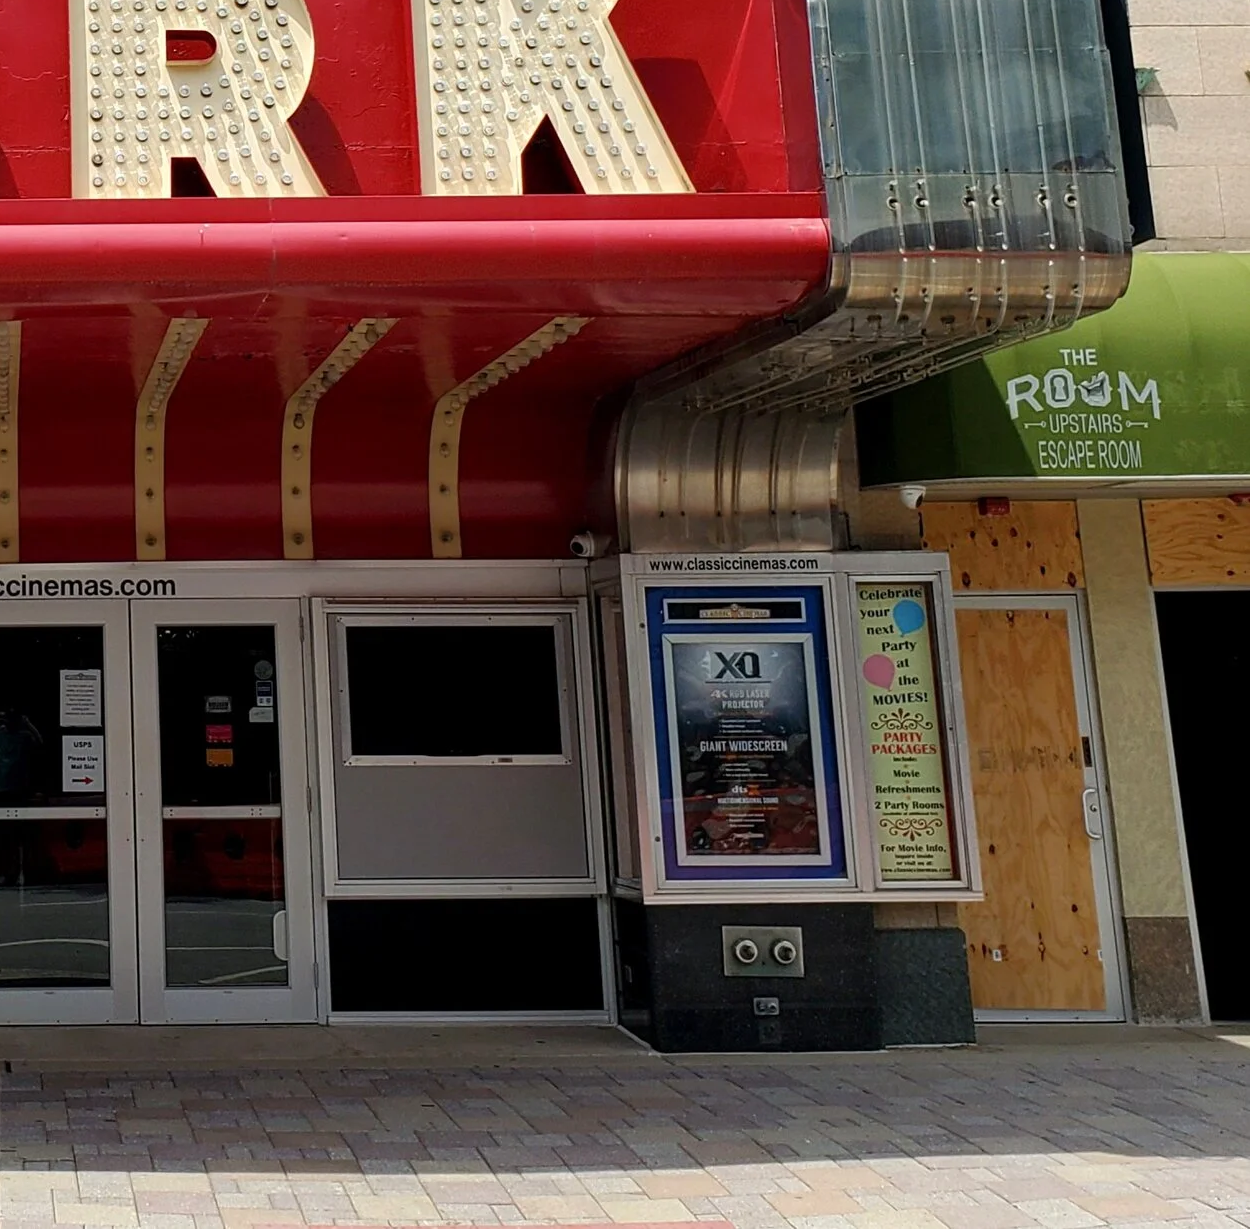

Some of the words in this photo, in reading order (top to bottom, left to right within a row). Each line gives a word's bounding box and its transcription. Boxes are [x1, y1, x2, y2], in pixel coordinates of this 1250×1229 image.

[1059, 348, 1098, 366] THE
[1005, 368, 1162, 420] ROOM
[1050, 413, 1123, 434] UPSTAIRS
[1038, 440, 1095, 469] ESCAPE
[1098, 440, 1143, 469] ROOM
[649, 557, 819, 571] www.classiccinemas.com
[859, 588, 923, 601] Celebrate
[860, 608, 890, 620] your
[866, 624, 895, 635] next
[881, 640, 917, 652] Party
[896, 658, 910, 669] at
[898, 675, 920, 686] the
[746, 689, 770, 698] LASER
[872, 691, 929, 706] MOVIES!
[722, 700, 765, 709] PROJECTOR
[883, 731, 923, 742] PARTY
[700, 740, 727, 752] GIANT
[728, 740, 788, 752] WIDESCREEN
[871, 744, 938, 755] PACKAGES
[893, 769, 920, 778] Movie
[731, 785, 748, 794] dts
[875, 785, 941, 794] Refreshments
[874, 801, 882, 810] 2
[884, 801, 910, 811] Party
[912, 801, 945, 810] Rooms
[881, 844, 896, 853] For
[898, 844, 923, 853] Movie
[926, 844, 947, 854] Info,
